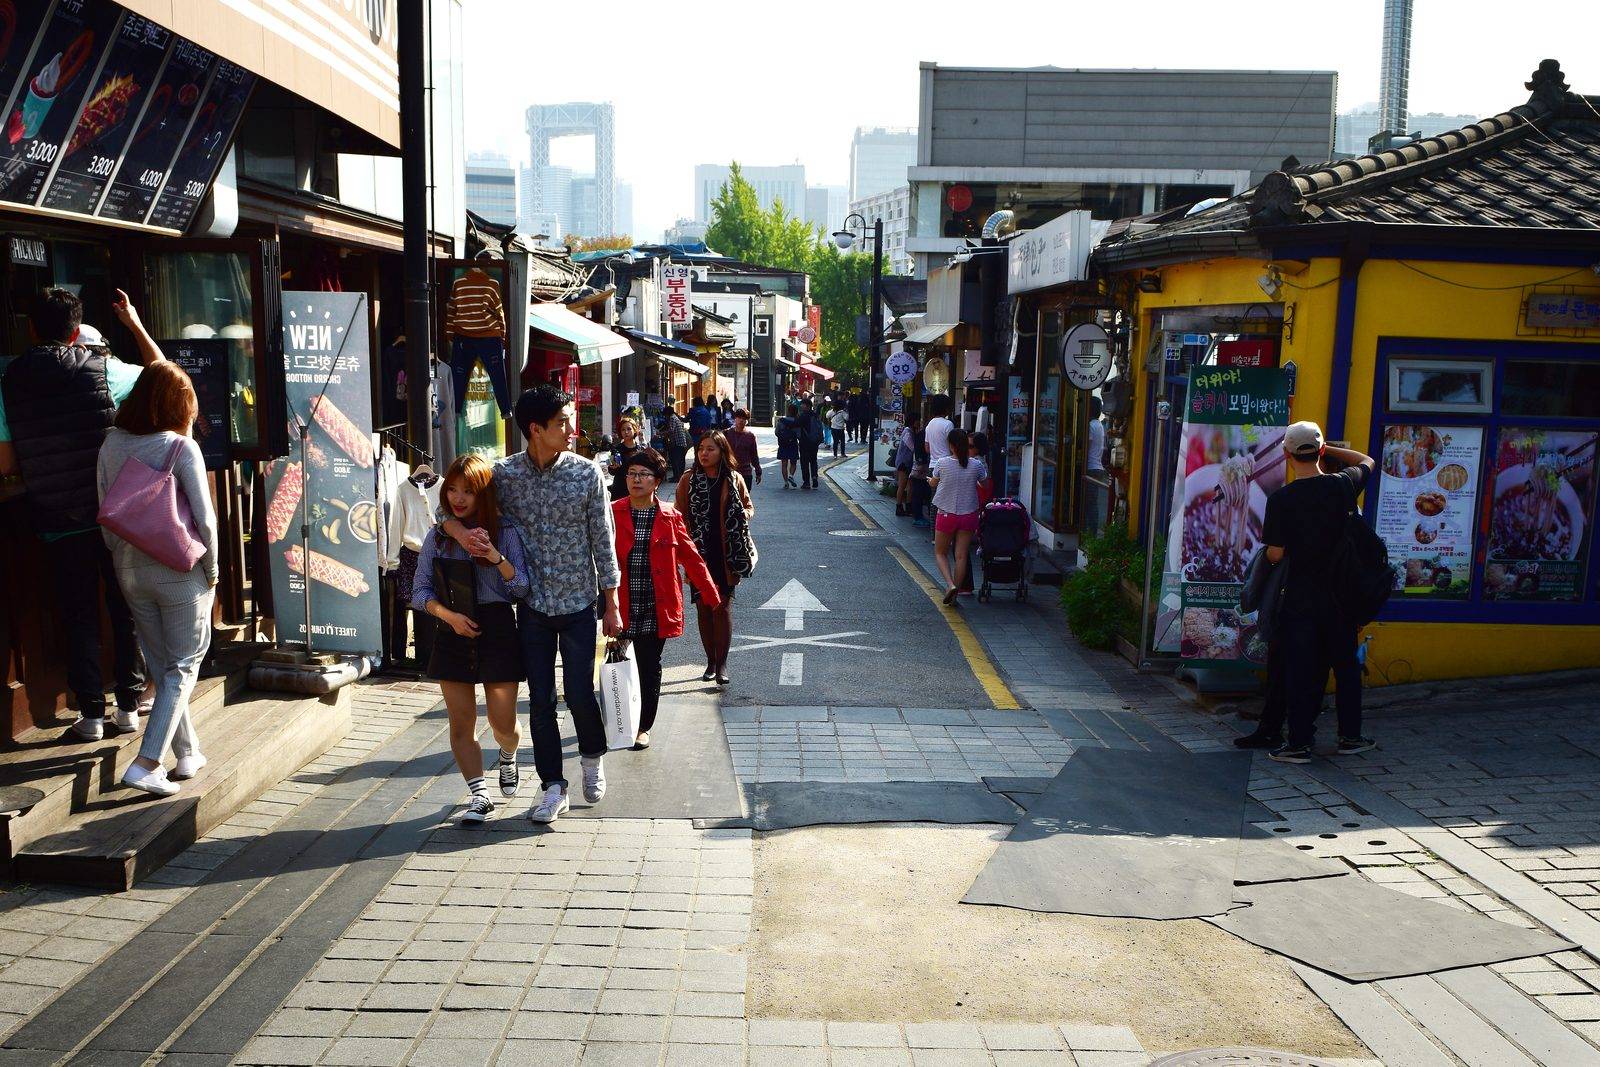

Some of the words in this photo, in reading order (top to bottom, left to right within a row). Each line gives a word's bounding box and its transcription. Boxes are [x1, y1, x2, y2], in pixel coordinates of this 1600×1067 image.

[27, 140, 58, 163] 3,000
[87, 155, 115, 177] 3,800
[140, 168, 163, 189] 4,000
[184, 180, 205, 198] 5,000
[664, 268, 688, 278] 신영
[666, 279, 688, 322] 부동산
[611, 668, 624, 734] www.giordano.co.kr
